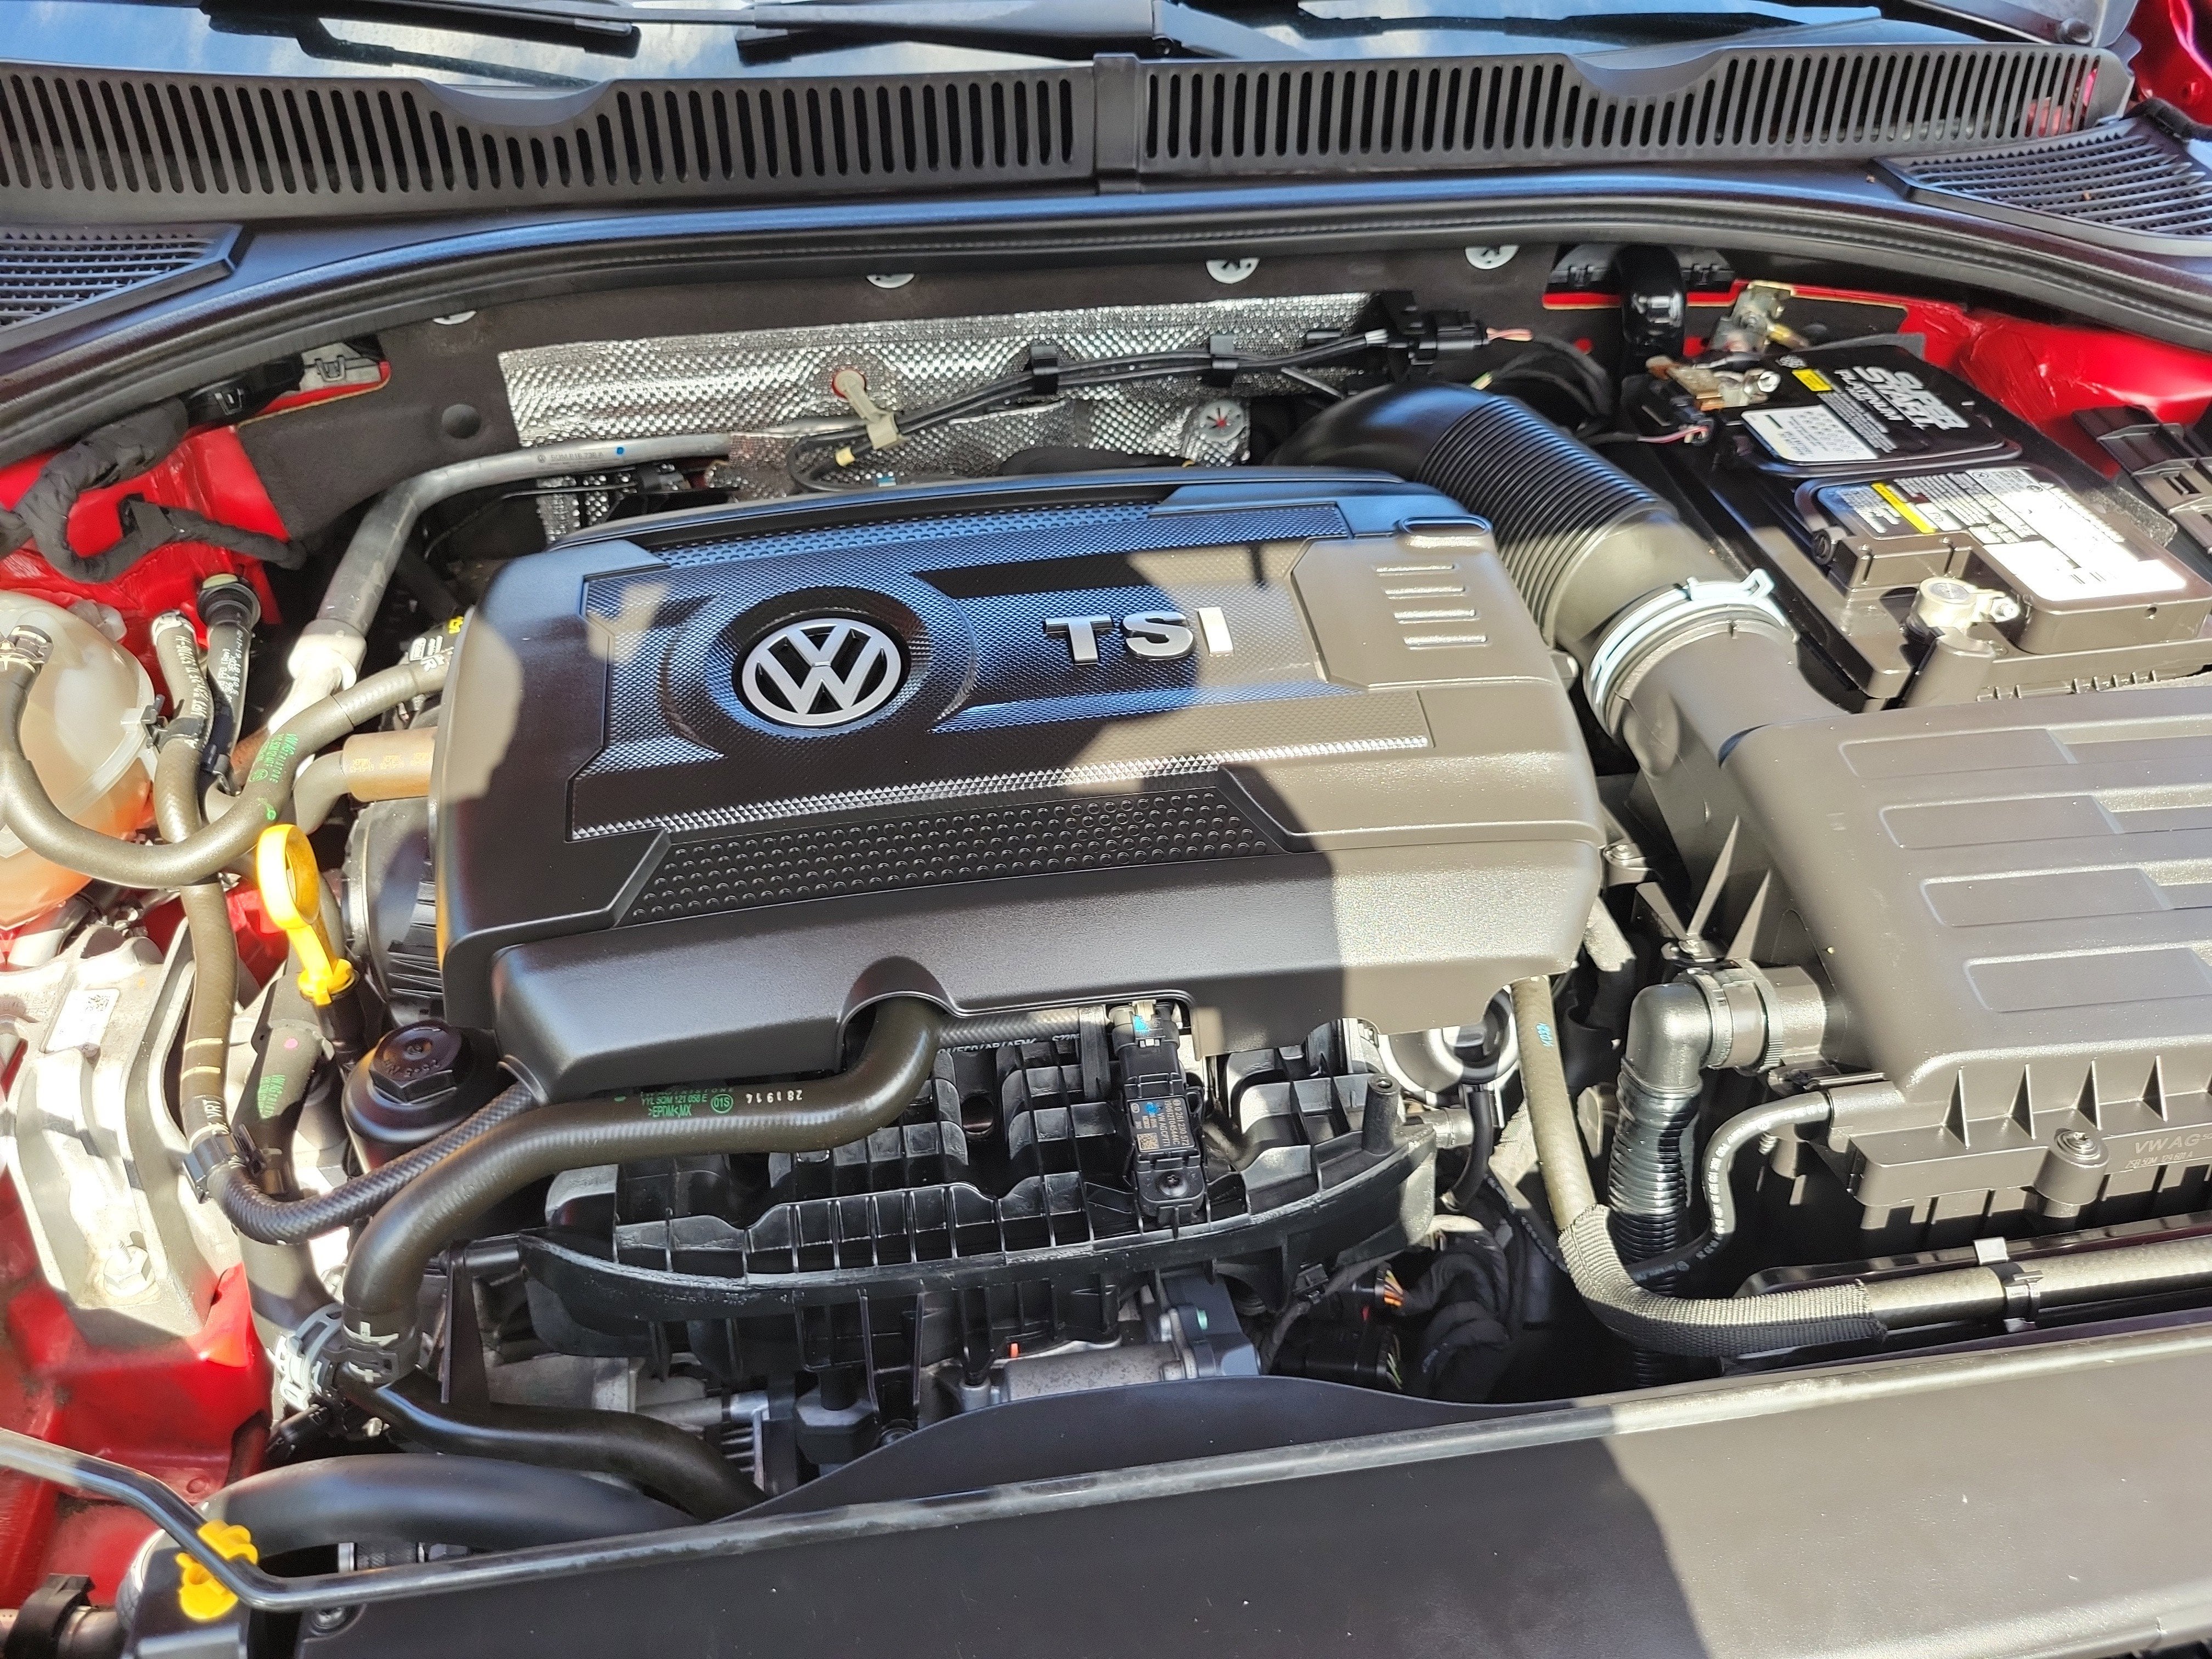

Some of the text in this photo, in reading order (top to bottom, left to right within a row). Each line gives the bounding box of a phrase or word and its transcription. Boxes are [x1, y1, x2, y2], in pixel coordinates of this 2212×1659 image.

[1834, 369, 1905, 421] PLATINUM
[1852, 365, 1936, 430] START
[1893, 370, 1970, 430] SUPER
[1043, 606, 1233, 665] TSI
[202, 1099, 223, 1119] VRT
[787, 1089, 803, 1102] 28
[1178, 1123, 1187, 1134] 230
[2135, 1138, 2169, 1154] VW
[2168, 1133, 2200, 1150] AG
